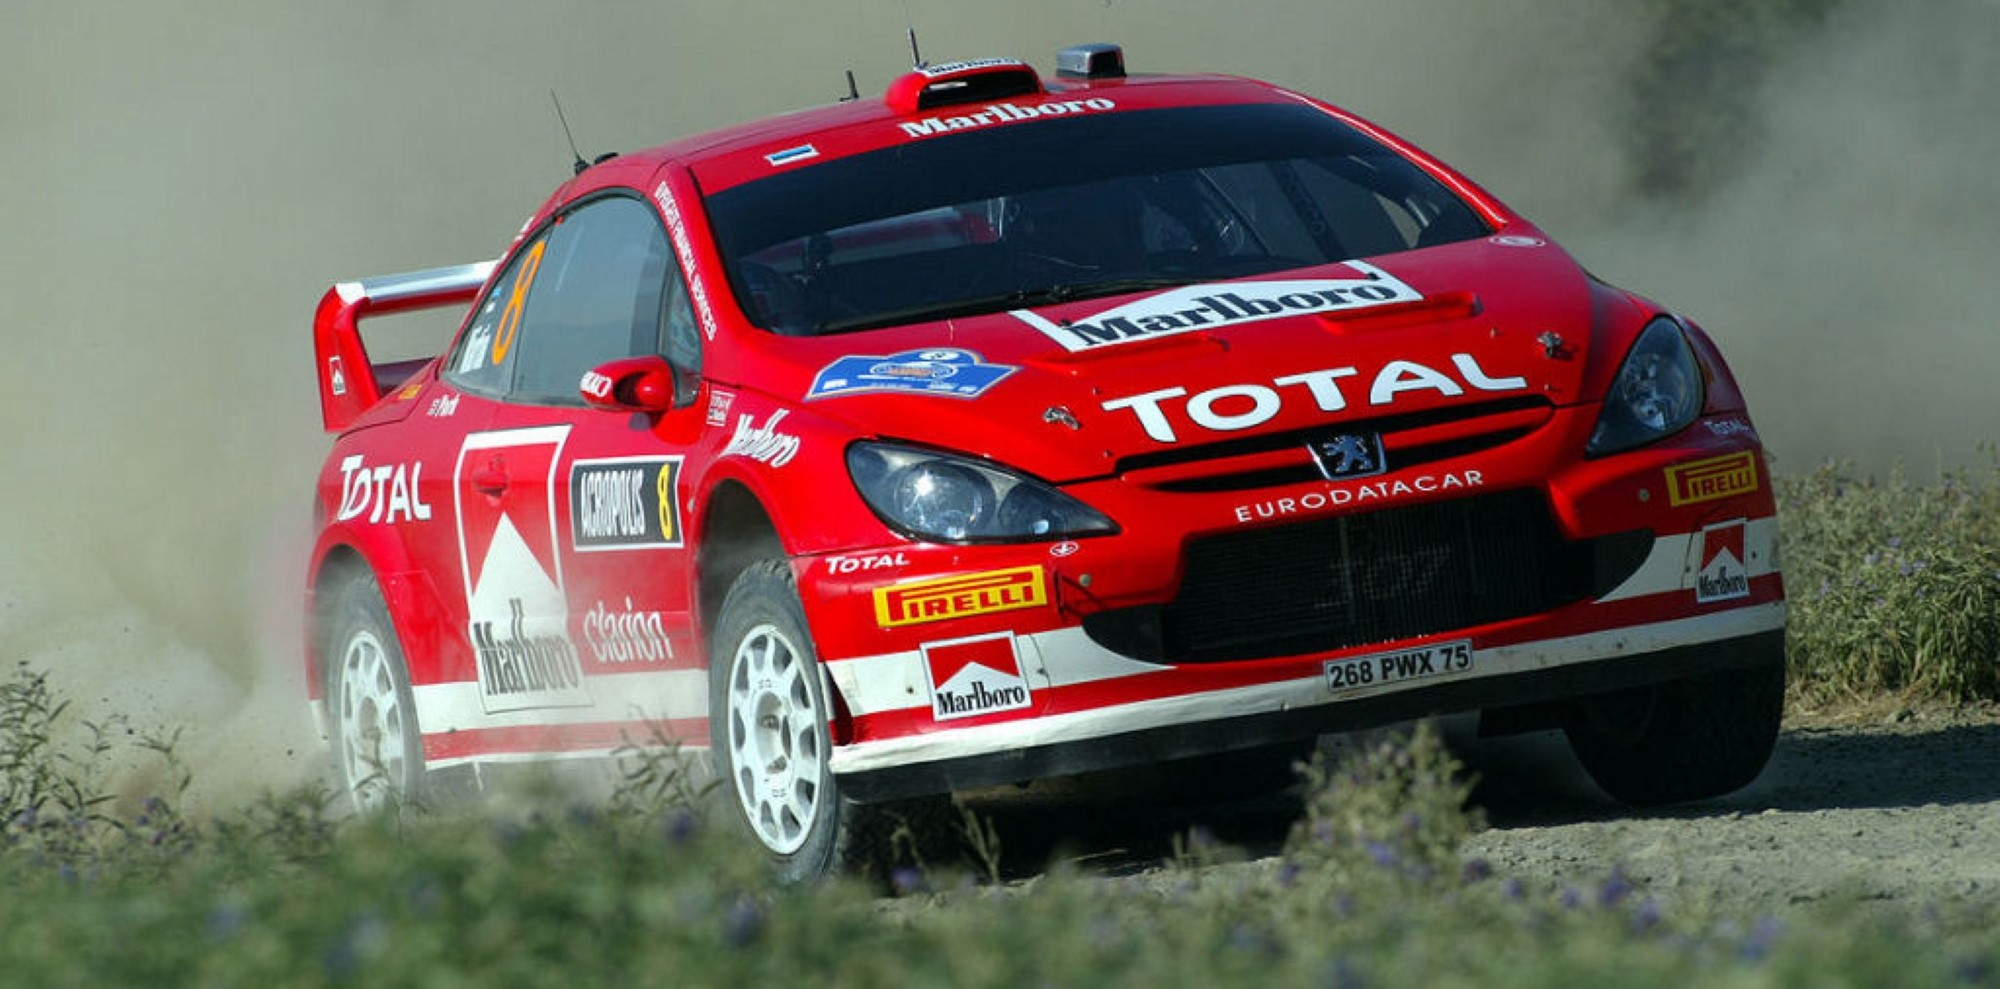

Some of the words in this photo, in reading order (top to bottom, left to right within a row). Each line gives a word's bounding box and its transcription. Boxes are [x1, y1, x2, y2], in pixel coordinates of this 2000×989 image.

[898, 97, 1116, 138] Marlboro
[491, 240, 547, 366] 8
[1067, 284, 1399, 346] Marlboro
[1101, 352, 1528, 443] TOTAL
[337, 453, 432, 525] TOTAL
[581, 467, 646, 538] ACROPOLIS
[656, 462, 673, 541] 8
[1234, 469, 1484, 523] EURODATACAR
[1674, 455, 1752, 501] PIRELLI
[825, 552, 911, 575] TOTAL
[1700, 565, 1746, 597] Marlboro
[885, 571, 1035, 622] PIRELLI
[473, 597, 580, 696] Marlboro
[584, 596, 674, 663] clarion
[1329, 660, 1374, 689] 268
[1380, 651, 1435, 681] PWX
[1440, 646, 1470, 671] 75
[936, 681, 1026, 716] Marlboro
